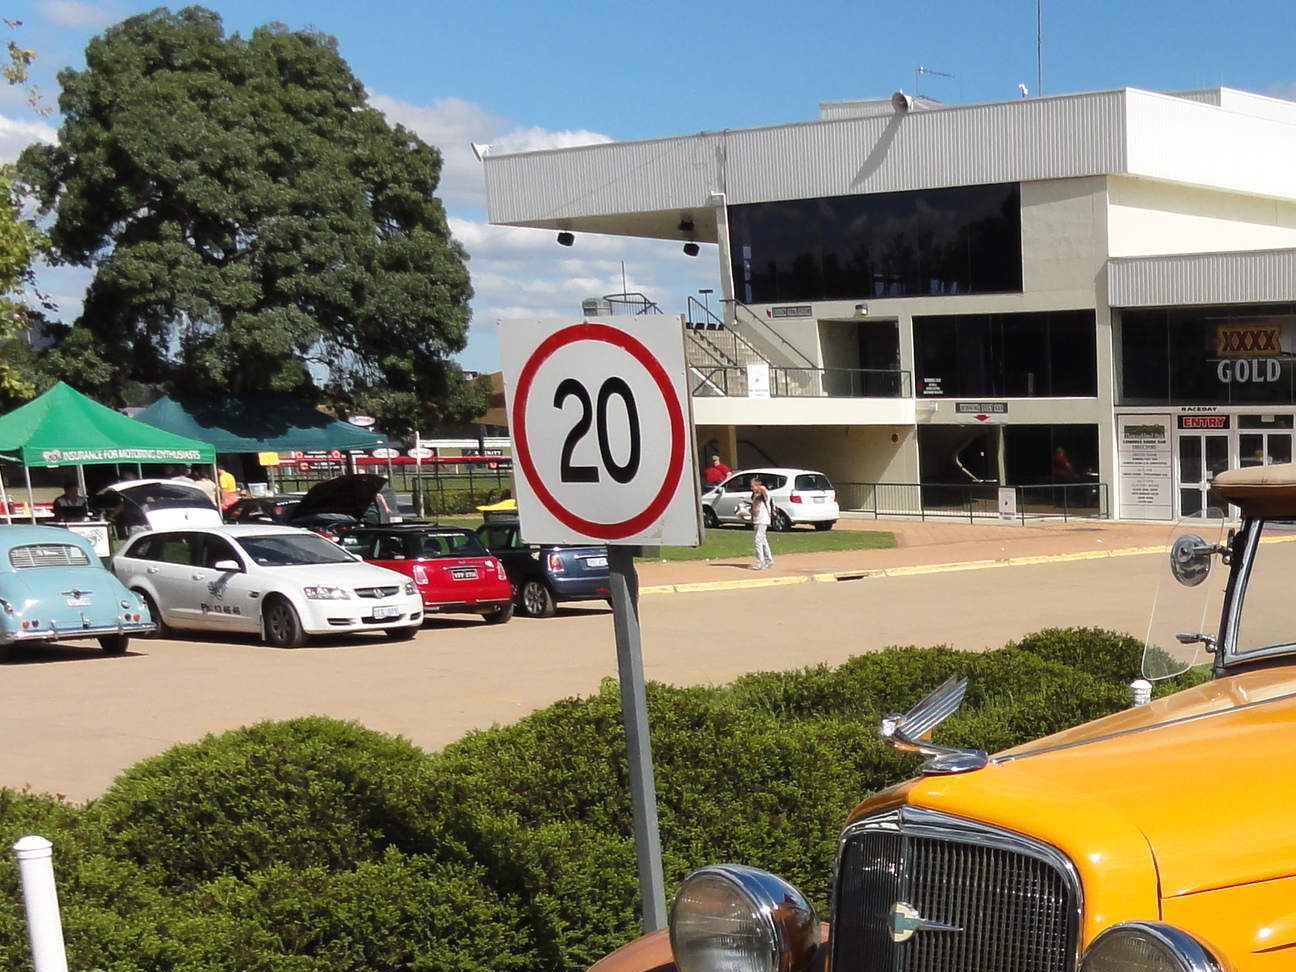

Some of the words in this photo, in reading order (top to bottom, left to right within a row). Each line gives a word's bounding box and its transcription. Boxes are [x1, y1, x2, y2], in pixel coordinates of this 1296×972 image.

[1221, 329, 1277, 352] XXXX
[1217, 358, 1281, 383] GOLD
[553, 376, 641, 484] 20
[1183, 416, 1226, 428] ENTRY
[63, 451, 103, 461] INSURANCE
[104, 450, 118, 459] FOR
[119, 449, 156, 459] MOTORING
[156, 450, 201, 460] ENTHUSIASTS
